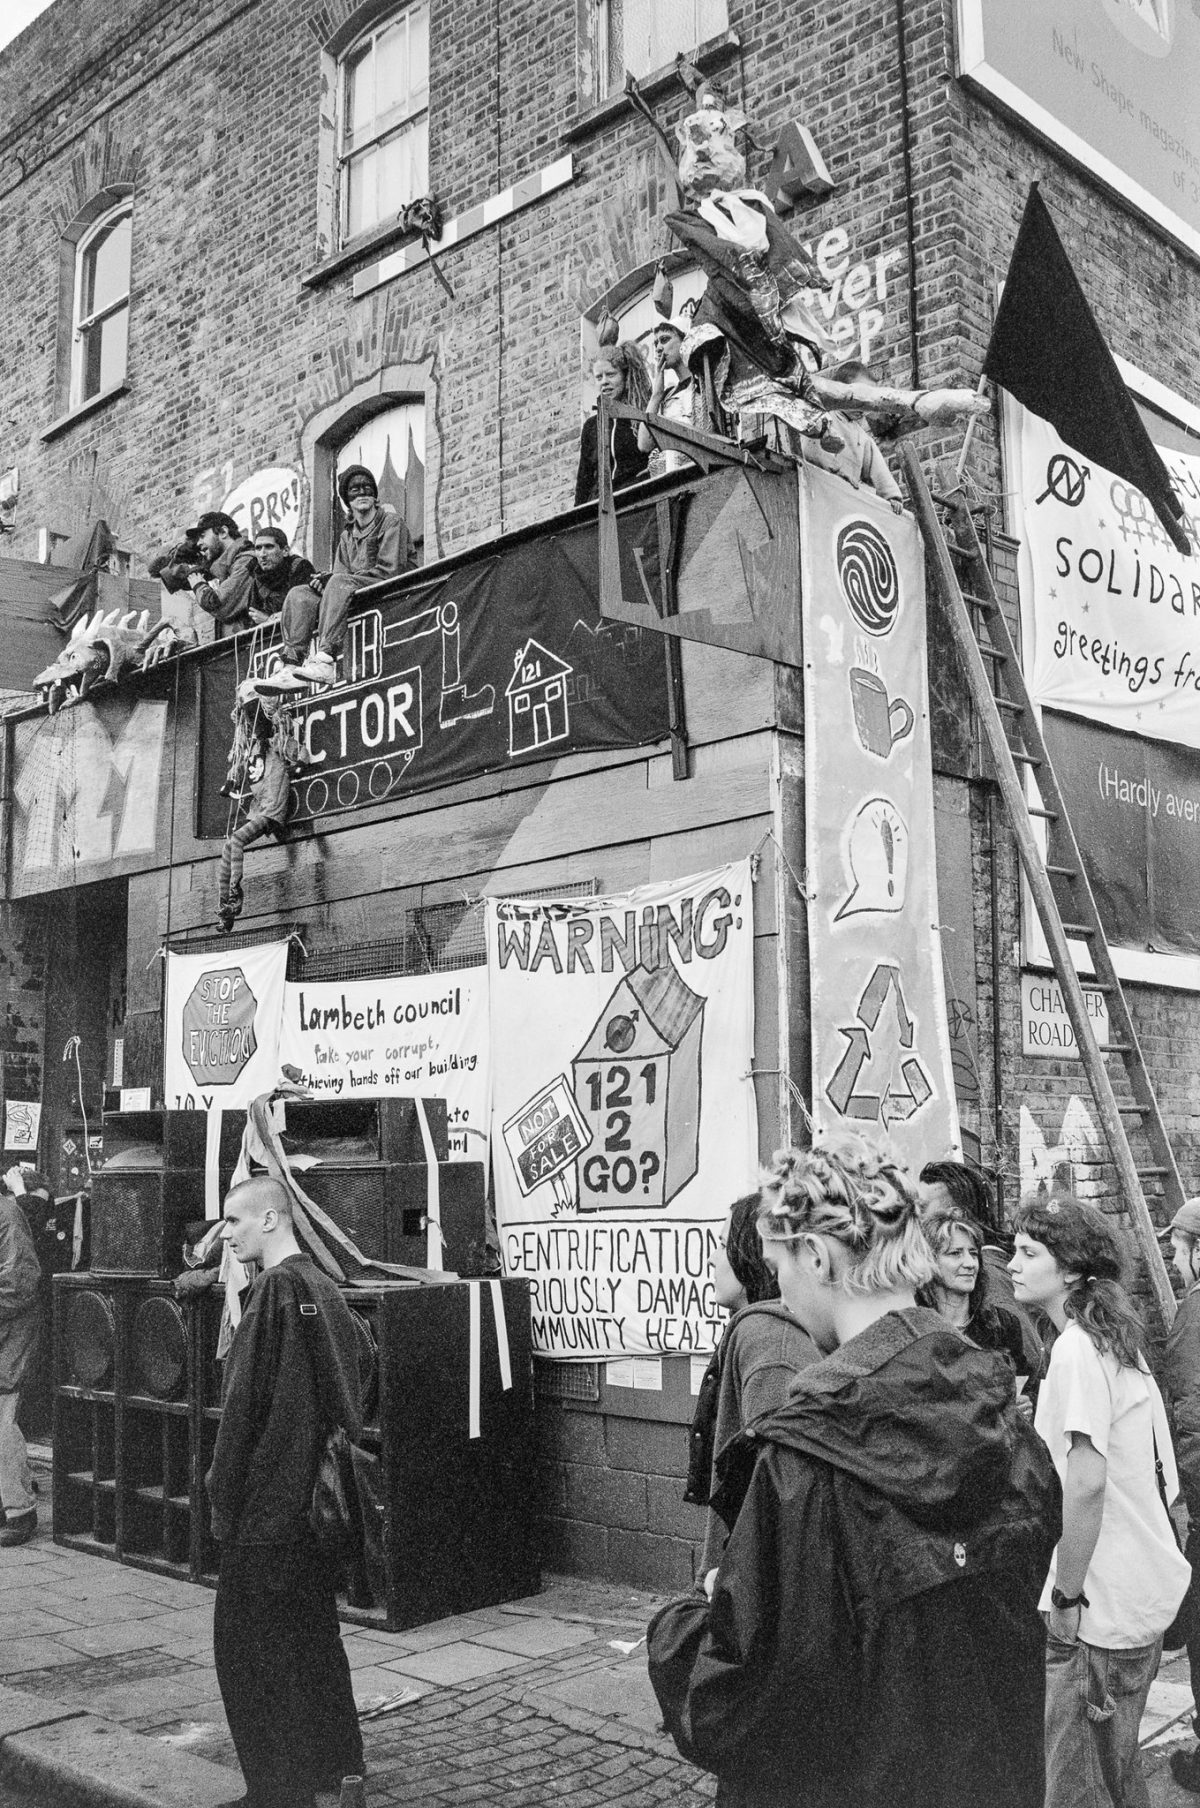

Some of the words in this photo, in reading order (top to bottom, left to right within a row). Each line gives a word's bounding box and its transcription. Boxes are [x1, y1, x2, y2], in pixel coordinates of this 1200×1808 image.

[1052, 27, 1084, 74] New
[522, 660, 541, 684] 121
[1054, 621, 1165, 692] greetings
[1098, 762, 1161, 818] (Hardly
[201, 975, 243, 1002] STOP
[1030, 986, 1104, 1018] CHAER
[205, 1002, 232, 1025] THE
[299, 991, 386, 1032] Lambeth
[189, 1026, 251, 1067] EVICTION
[346, 1048, 375, 1065] your
[299, 1073, 344, 1094] thieving
[350, 1069, 379, 1087] hands
[385, 1067, 401, 1085] off
[404, 1067, 423, 1081] our
[585, 1063, 657, 1111] 121
[520, 1100, 555, 1144] NOT
[604, 1110, 633, 1153] 2
[530, 1131, 556, 1160] FOR
[530, 1132, 578, 1180] SALE
[583, 1151, 661, 1194] GO?
[646, 1318, 728, 1351] HEALT
